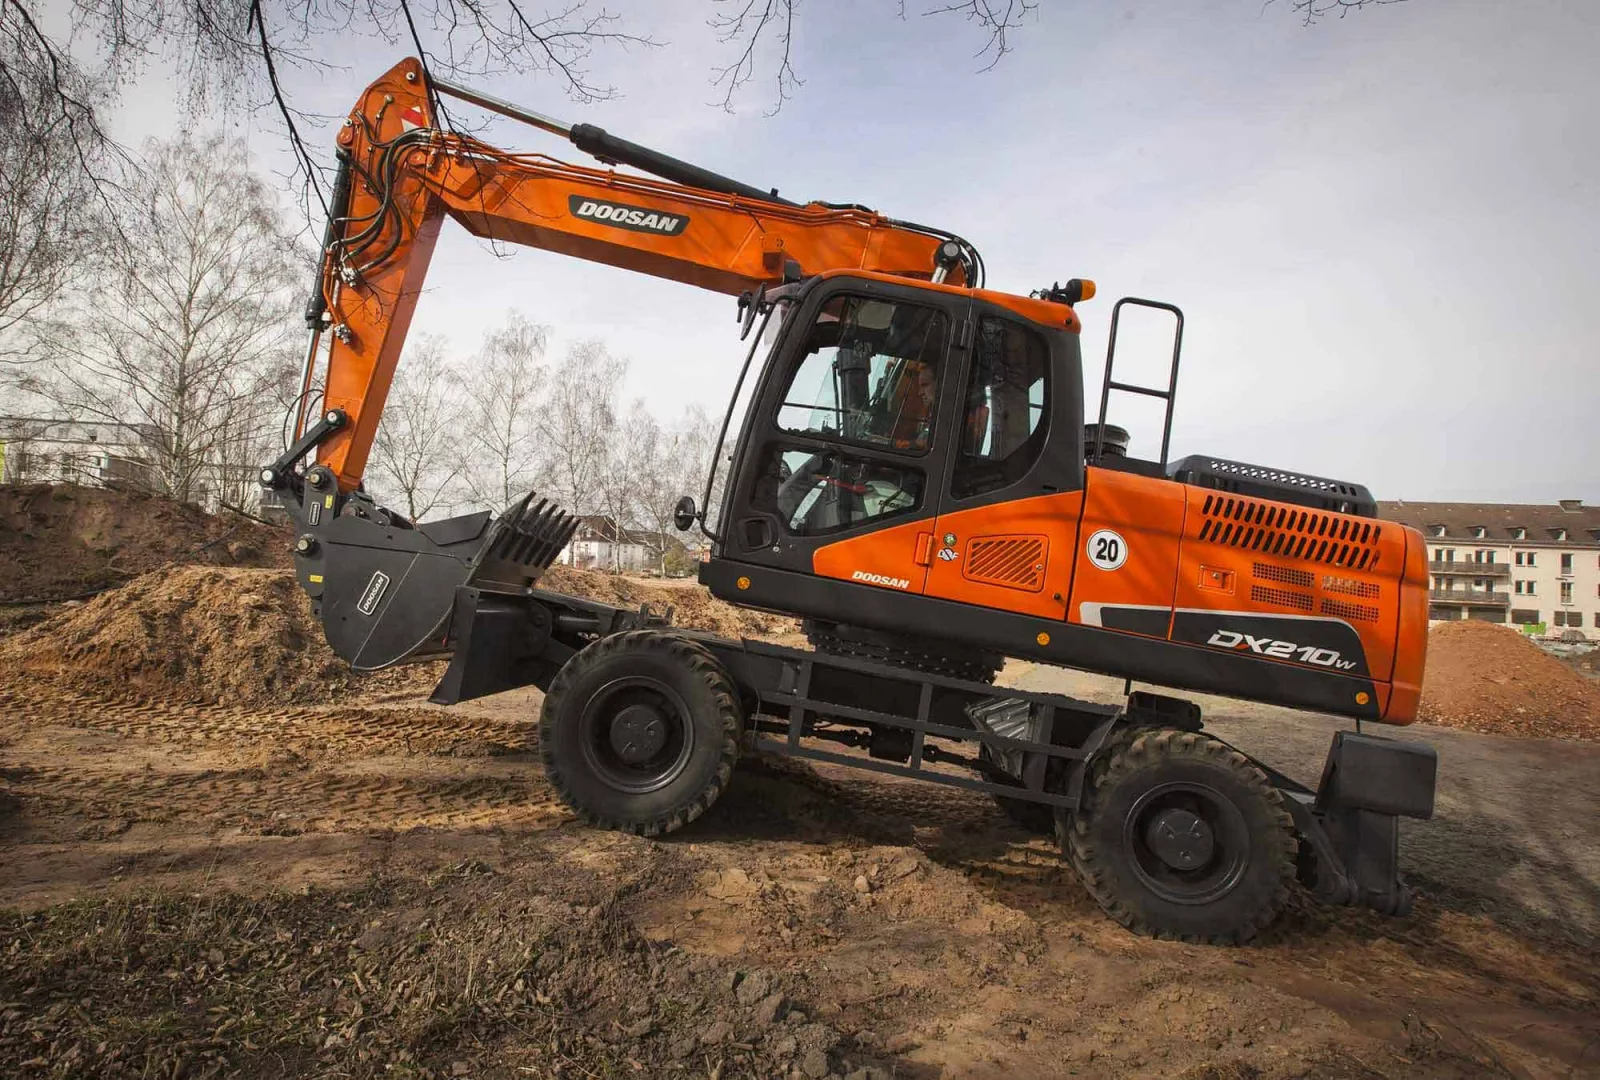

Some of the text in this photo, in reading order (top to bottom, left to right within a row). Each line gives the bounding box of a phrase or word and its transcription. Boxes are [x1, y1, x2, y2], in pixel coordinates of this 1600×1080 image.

[577, 201, 679, 232] DOOSAN
[1095, 537, 1119, 562] 20
[363, 576, 384, 611] DOOSAN
[851, 570, 910, 589] DOOSAN
